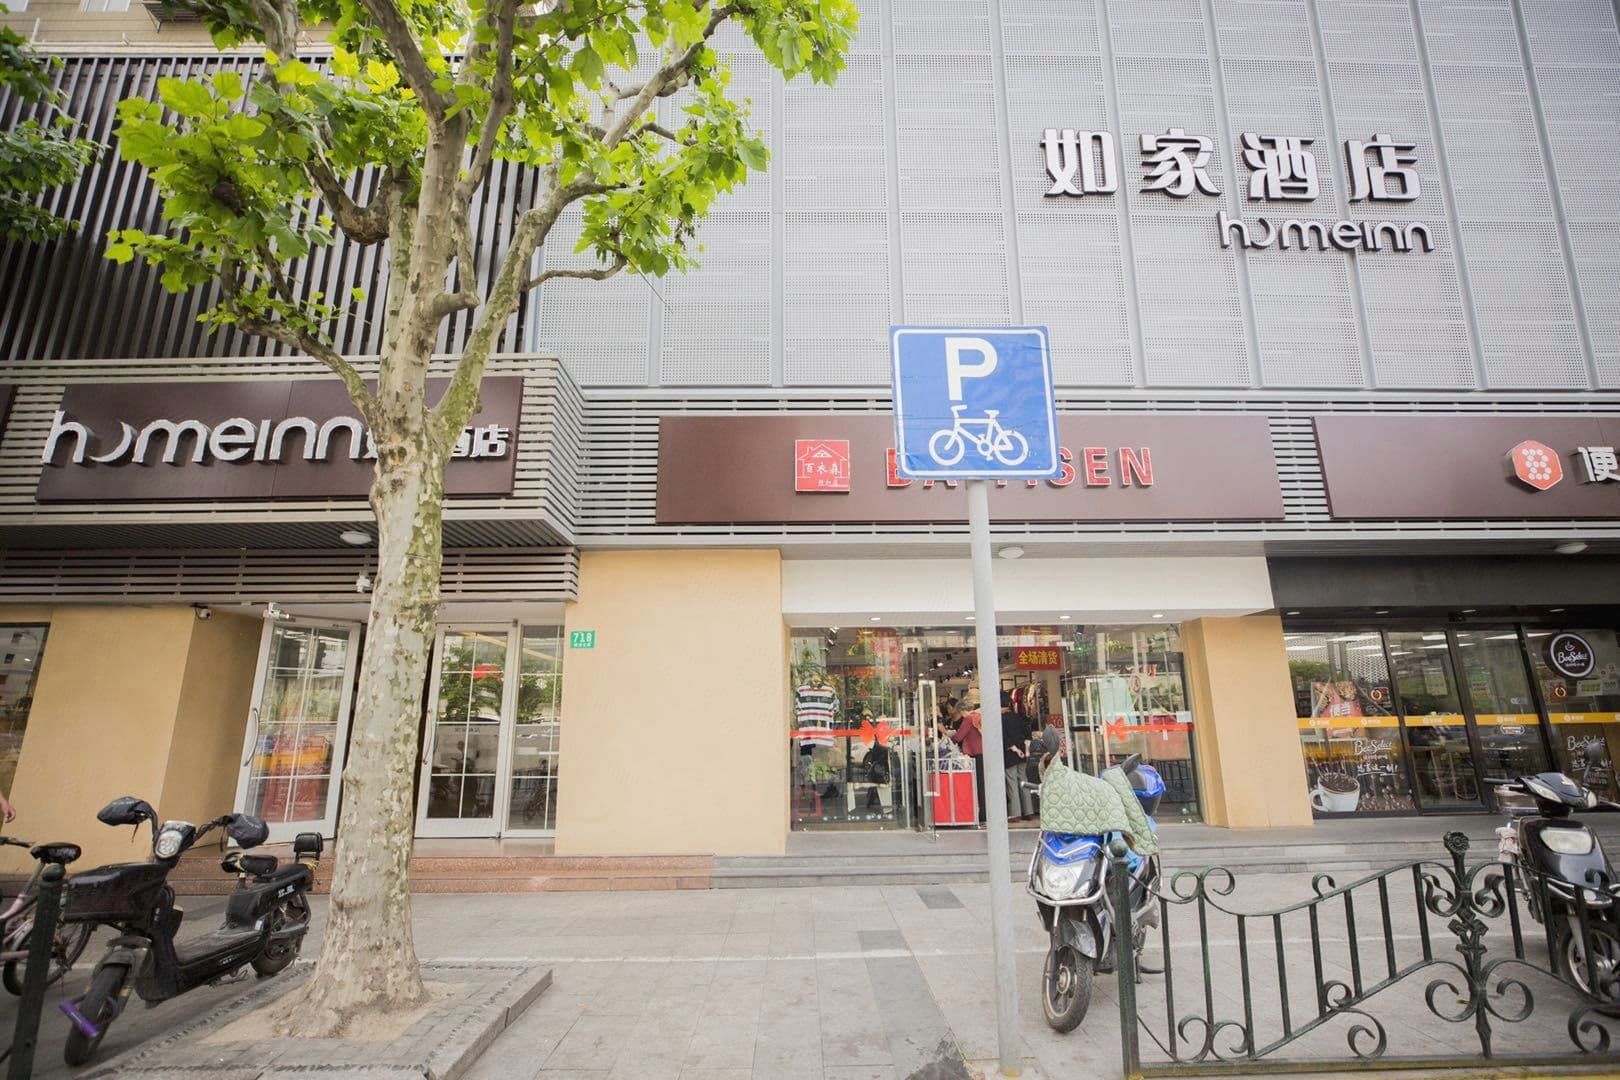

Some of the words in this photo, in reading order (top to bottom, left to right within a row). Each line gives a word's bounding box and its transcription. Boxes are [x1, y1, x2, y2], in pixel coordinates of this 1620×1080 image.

[1040, 128, 1421, 202] 如家酒店
[1217, 210, 1435, 252] homeinn
[944, 337, 998, 401] P
[42, 409, 363, 465] homeinn
[573, 632, 592, 643] 718
[1018, 650, 1058, 665] 全场清货
